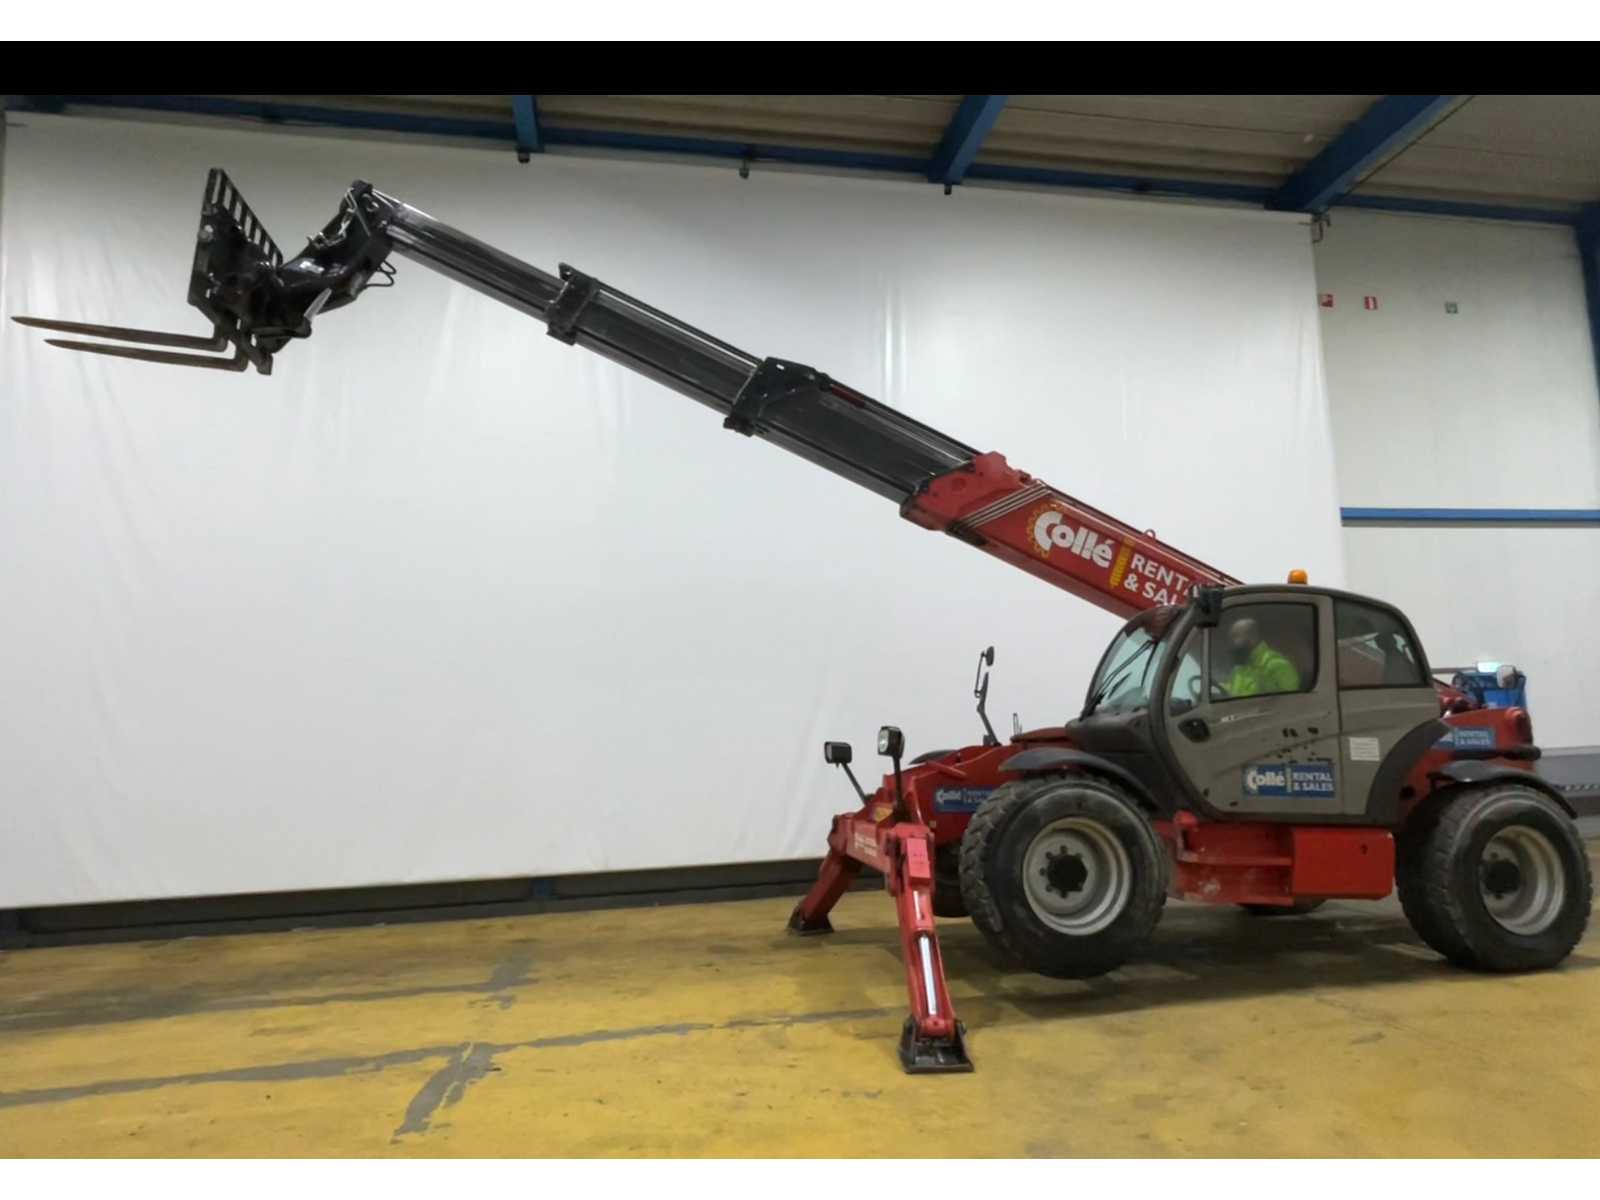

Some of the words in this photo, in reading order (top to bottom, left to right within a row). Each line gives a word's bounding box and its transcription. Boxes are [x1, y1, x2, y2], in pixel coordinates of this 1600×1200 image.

[1034, 510, 1115, 568] Collé
[1124, 573, 1138, 592] &
[1131, 553, 1199, 598] RENTA
[1247, 767, 1285, 790] Collé
[1293, 772, 1332, 782] RENTAL
[1303, 782, 1334, 792] SALES
